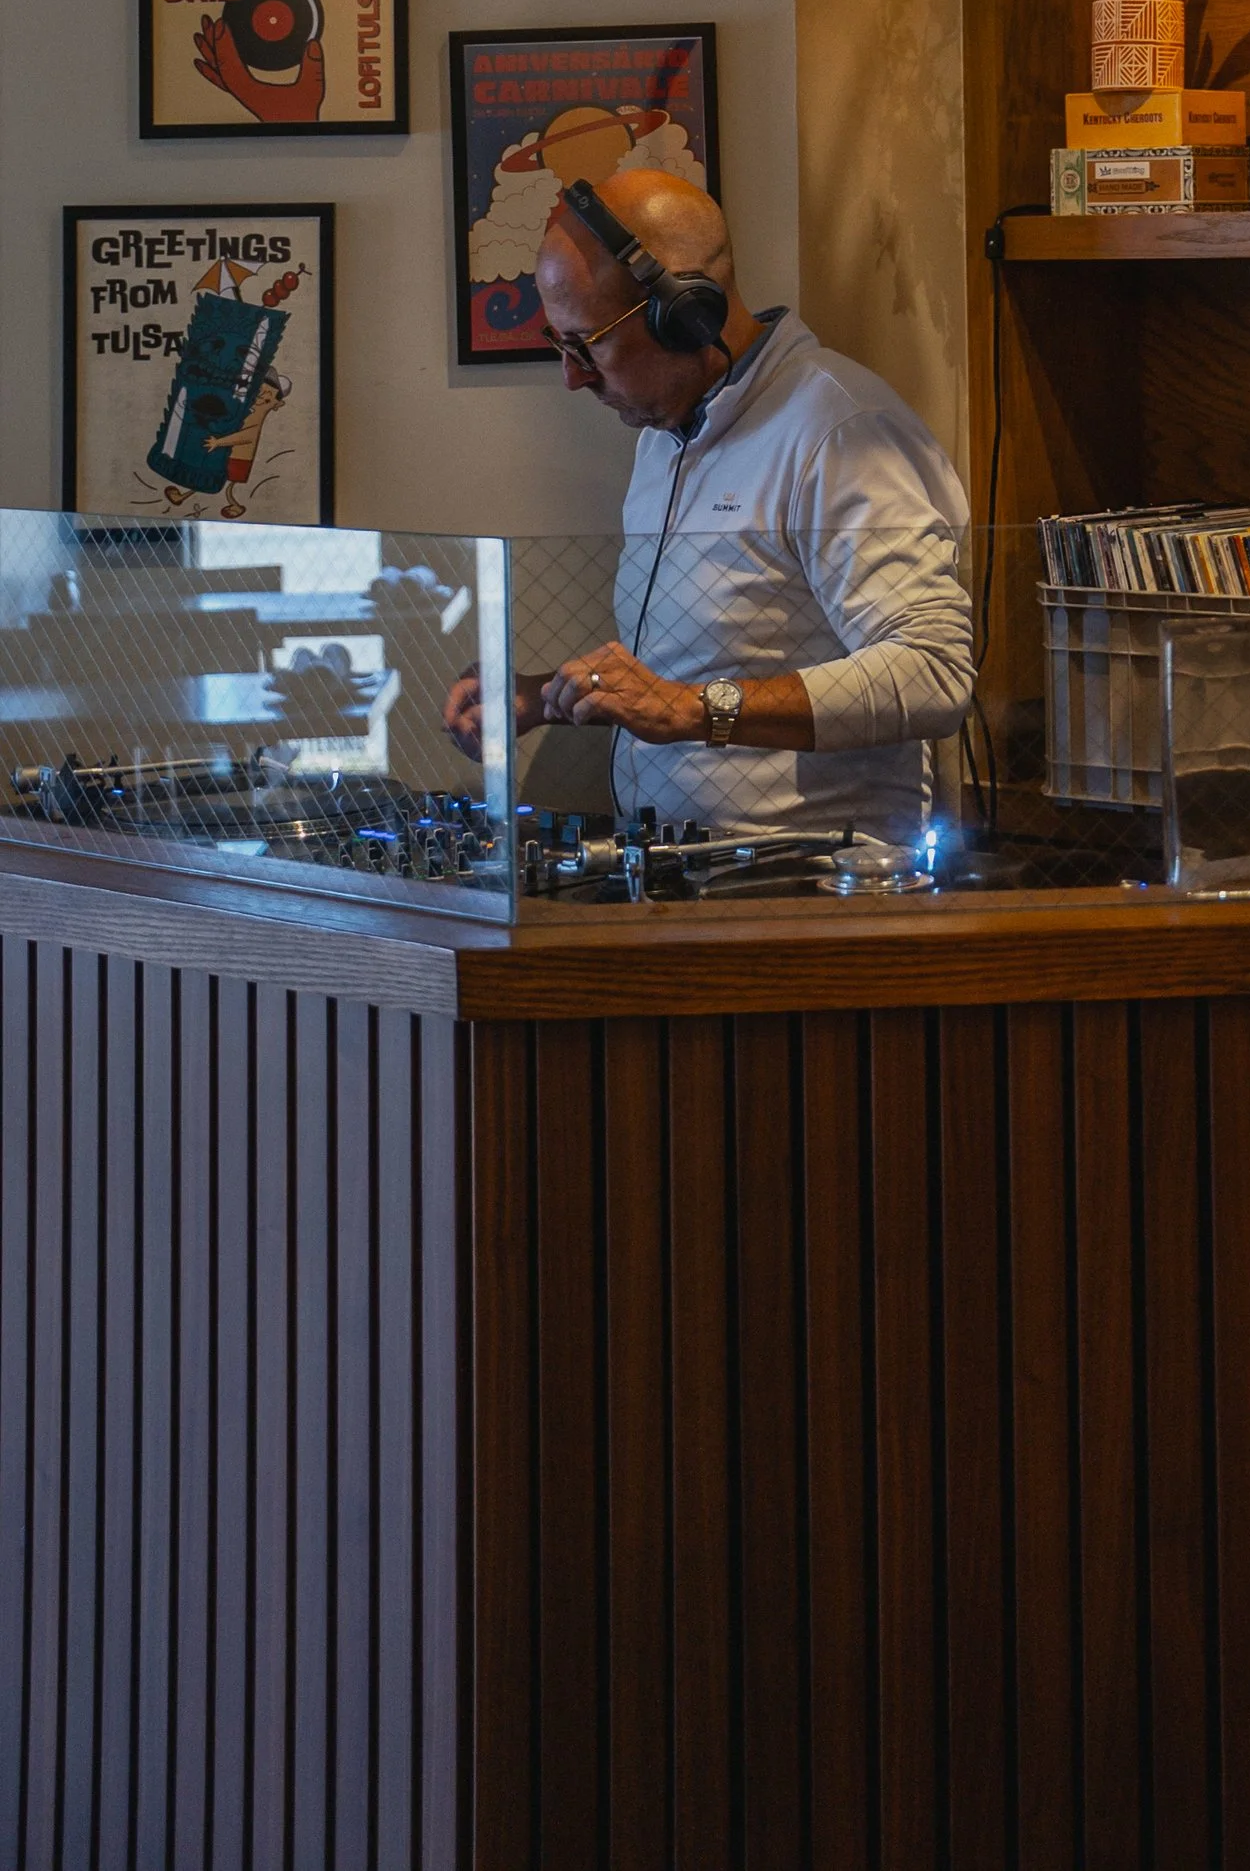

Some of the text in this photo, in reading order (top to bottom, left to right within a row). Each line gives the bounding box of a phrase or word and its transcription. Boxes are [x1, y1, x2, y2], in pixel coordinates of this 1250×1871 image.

[358, 55, 381, 109] LOFI
[472, 74, 690, 105] CARNIVALE
[1083, 111, 1164, 125] KENTUCKY CHEROOTS
[91, 228, 291, 268] GREETINGS
[91, 278, 178, 314] FROM
[91, 323, 184, 361] TULSA
[712, 503, 741, 512] SUMMIT
